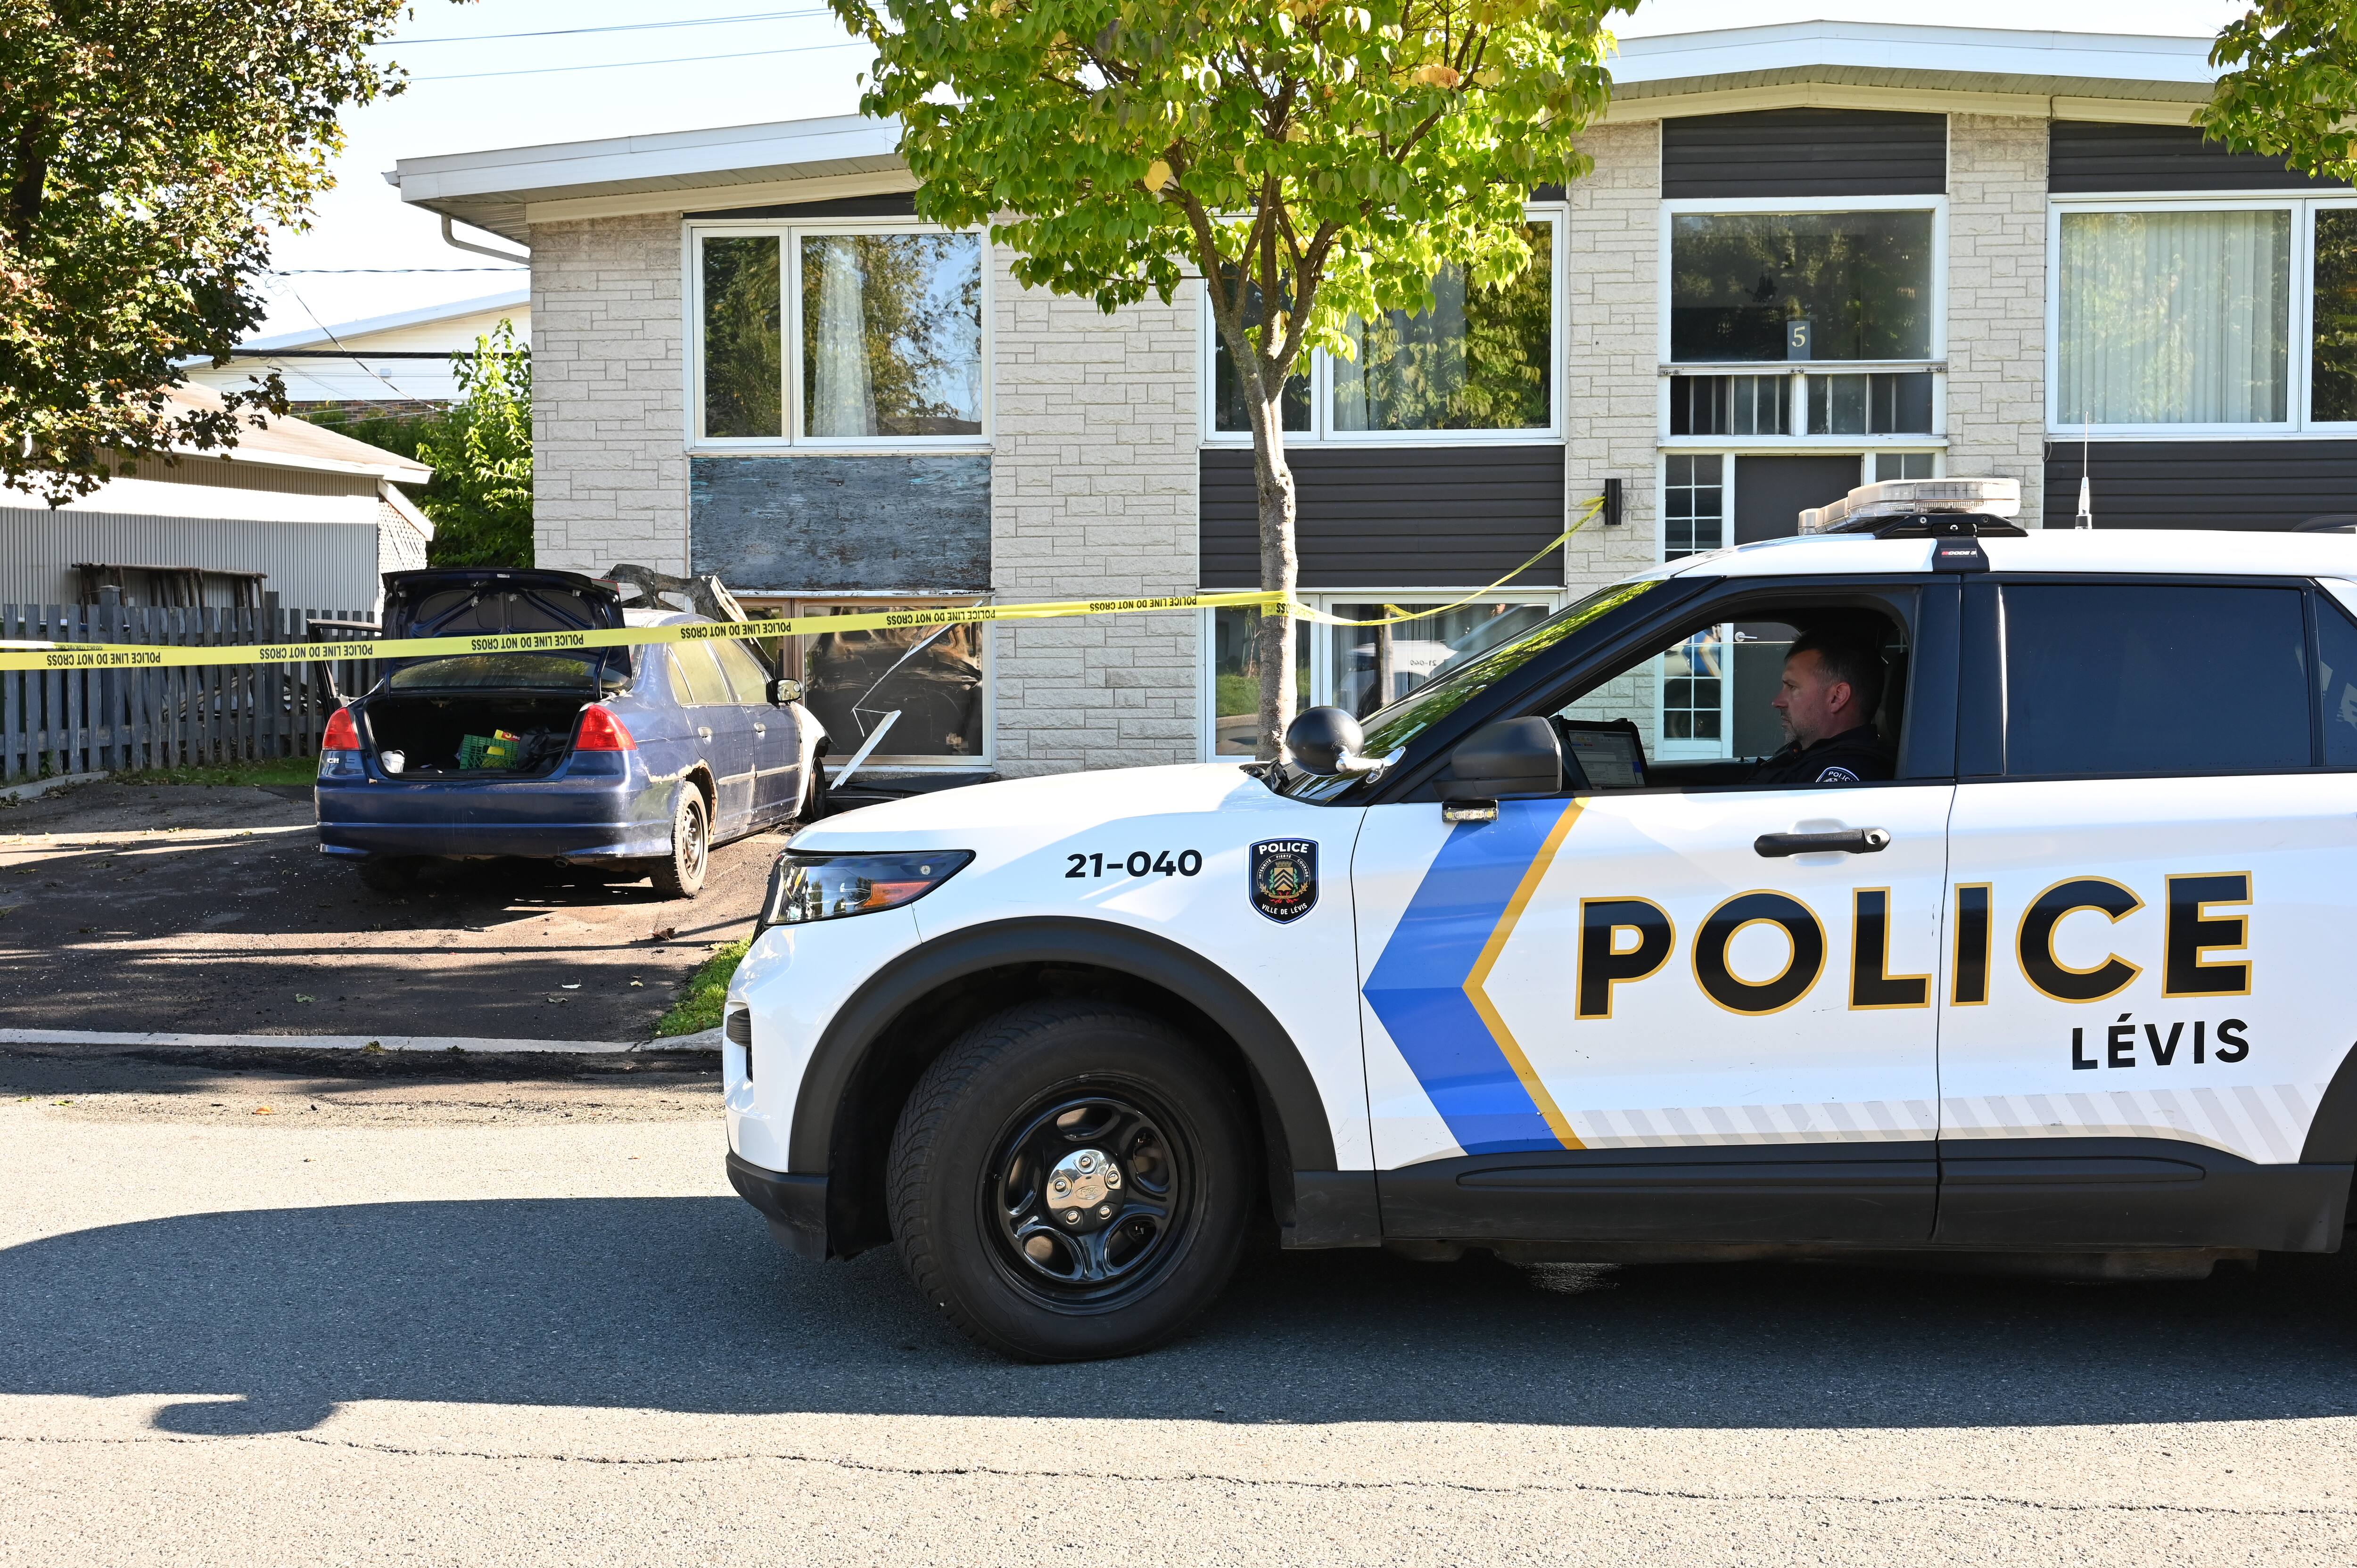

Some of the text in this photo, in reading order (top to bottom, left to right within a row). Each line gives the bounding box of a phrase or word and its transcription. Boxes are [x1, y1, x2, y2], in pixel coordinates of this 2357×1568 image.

[1791, 326, 1806, 347] 5
[1089, 596, 1197, 612] POLICE LINE DO NOT CROSS
[886, 609, 996, 625] POLICE LINE DO NOT CROSS
[680, 622, 791, 639] POLICE LINE DO NOT CROSS
[471, 634, 584, 651] POLICE LINE DO NOT CROSS
[47, 652, 161, 666] POLICE LINE DO NOT CROSS
[259, 644, 373, 660] POLICE LINE DO NOT CROSS
[1829, 771, 1853, 782] POLIC
[1259, 843, 1309, 854] POLICE
[1065, 849, 1202, 878] 21-040
[1259, 859, 1272, 879] INTÉGRITÉ
[1297, 859, 1309, 878] COURAGE
[1261, 903, 1277, 914] VILLE
[1291, 903, 1308, 914] LÉVIS
[1575, 870, 2253, 1020] POLICE
[2071, 1012, 2250, 1070] LÉVIS
